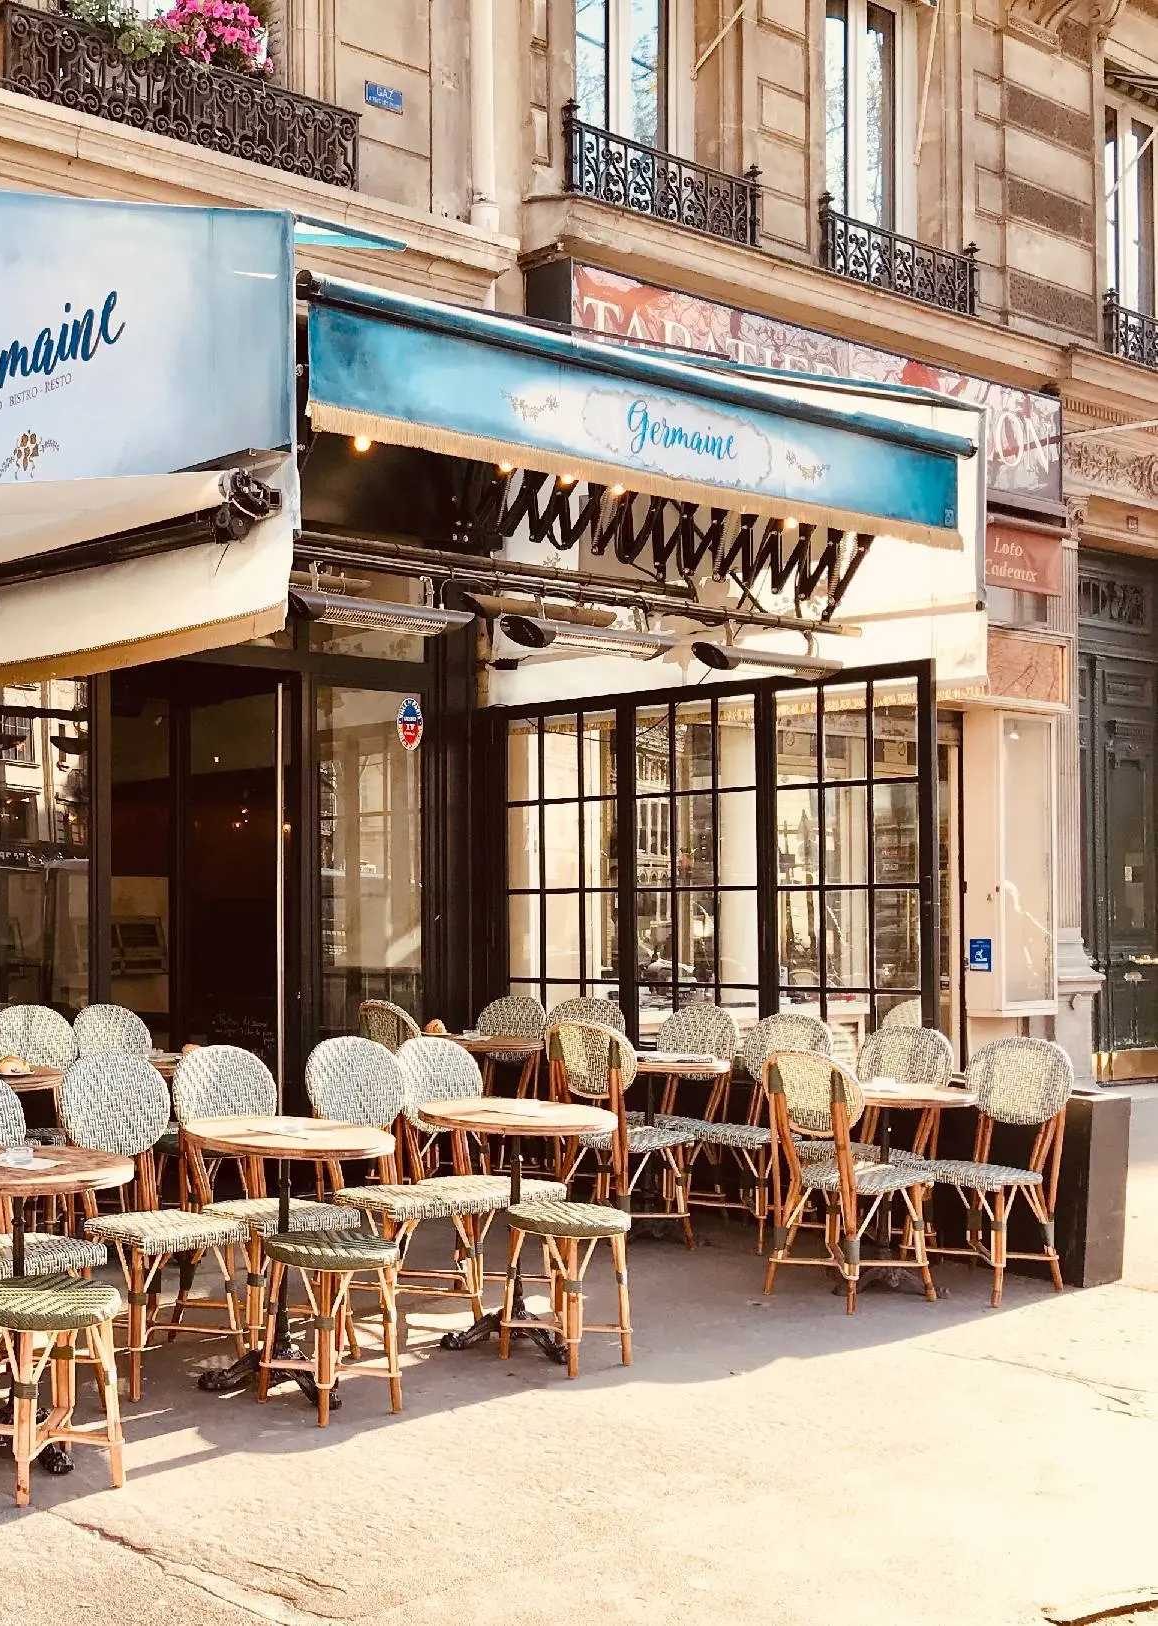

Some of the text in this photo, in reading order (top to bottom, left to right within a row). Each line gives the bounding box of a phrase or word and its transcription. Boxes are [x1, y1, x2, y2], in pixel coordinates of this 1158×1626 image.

[9, 386, 38, 407] BISTRO
[44, 372, 72, 393] RESTO
[627, 399, 738, 461] Germaine
[993, 537, 1023, 557] Loto
